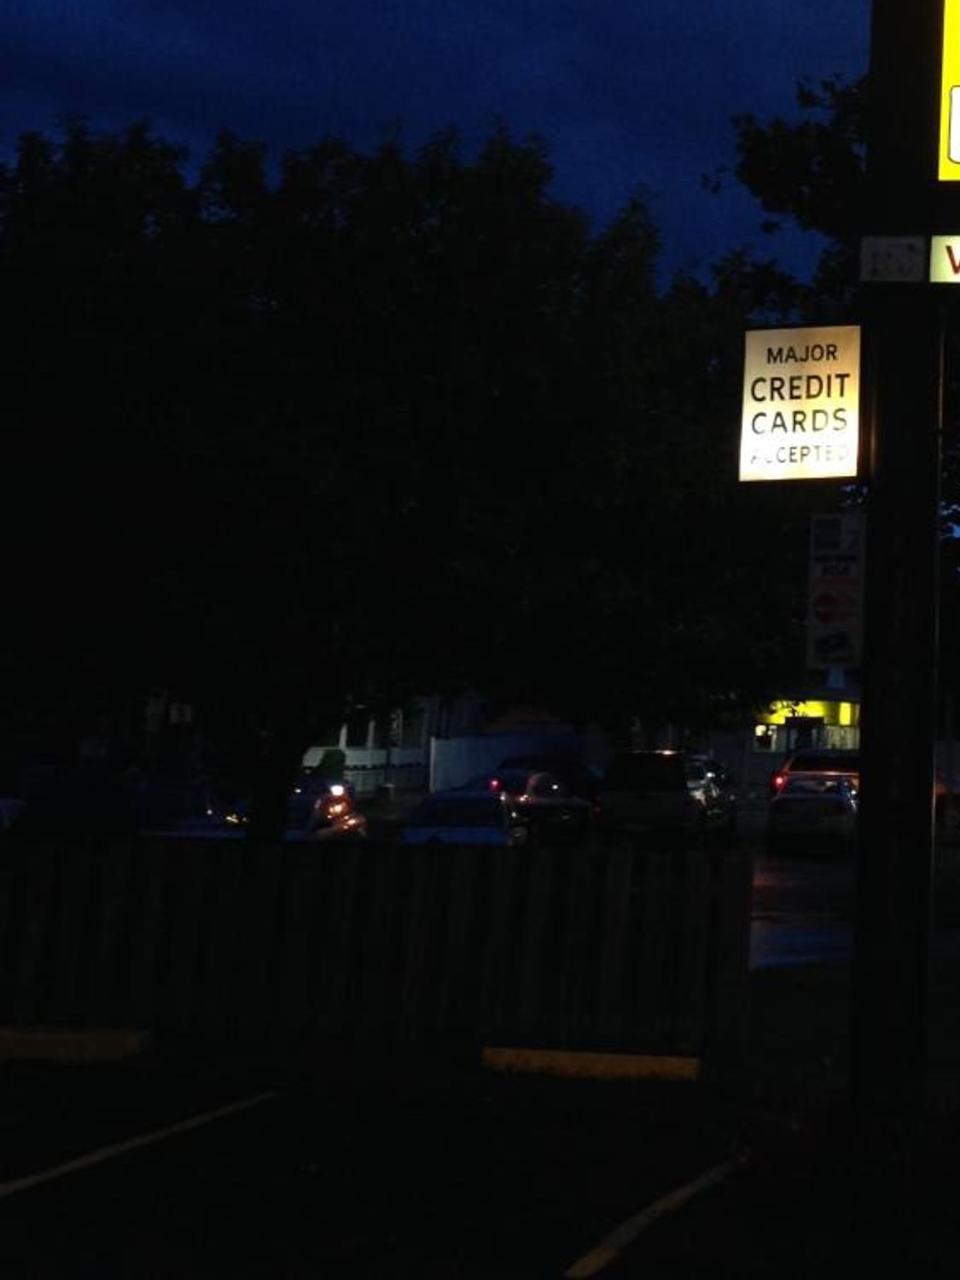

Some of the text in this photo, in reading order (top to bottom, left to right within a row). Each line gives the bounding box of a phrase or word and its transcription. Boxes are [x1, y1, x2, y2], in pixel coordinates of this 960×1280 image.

[766, 344, 838, 364] MAJOR
[751, 373, 850, 402] CREDIT
[751, 407, 848, 434] CARDS
